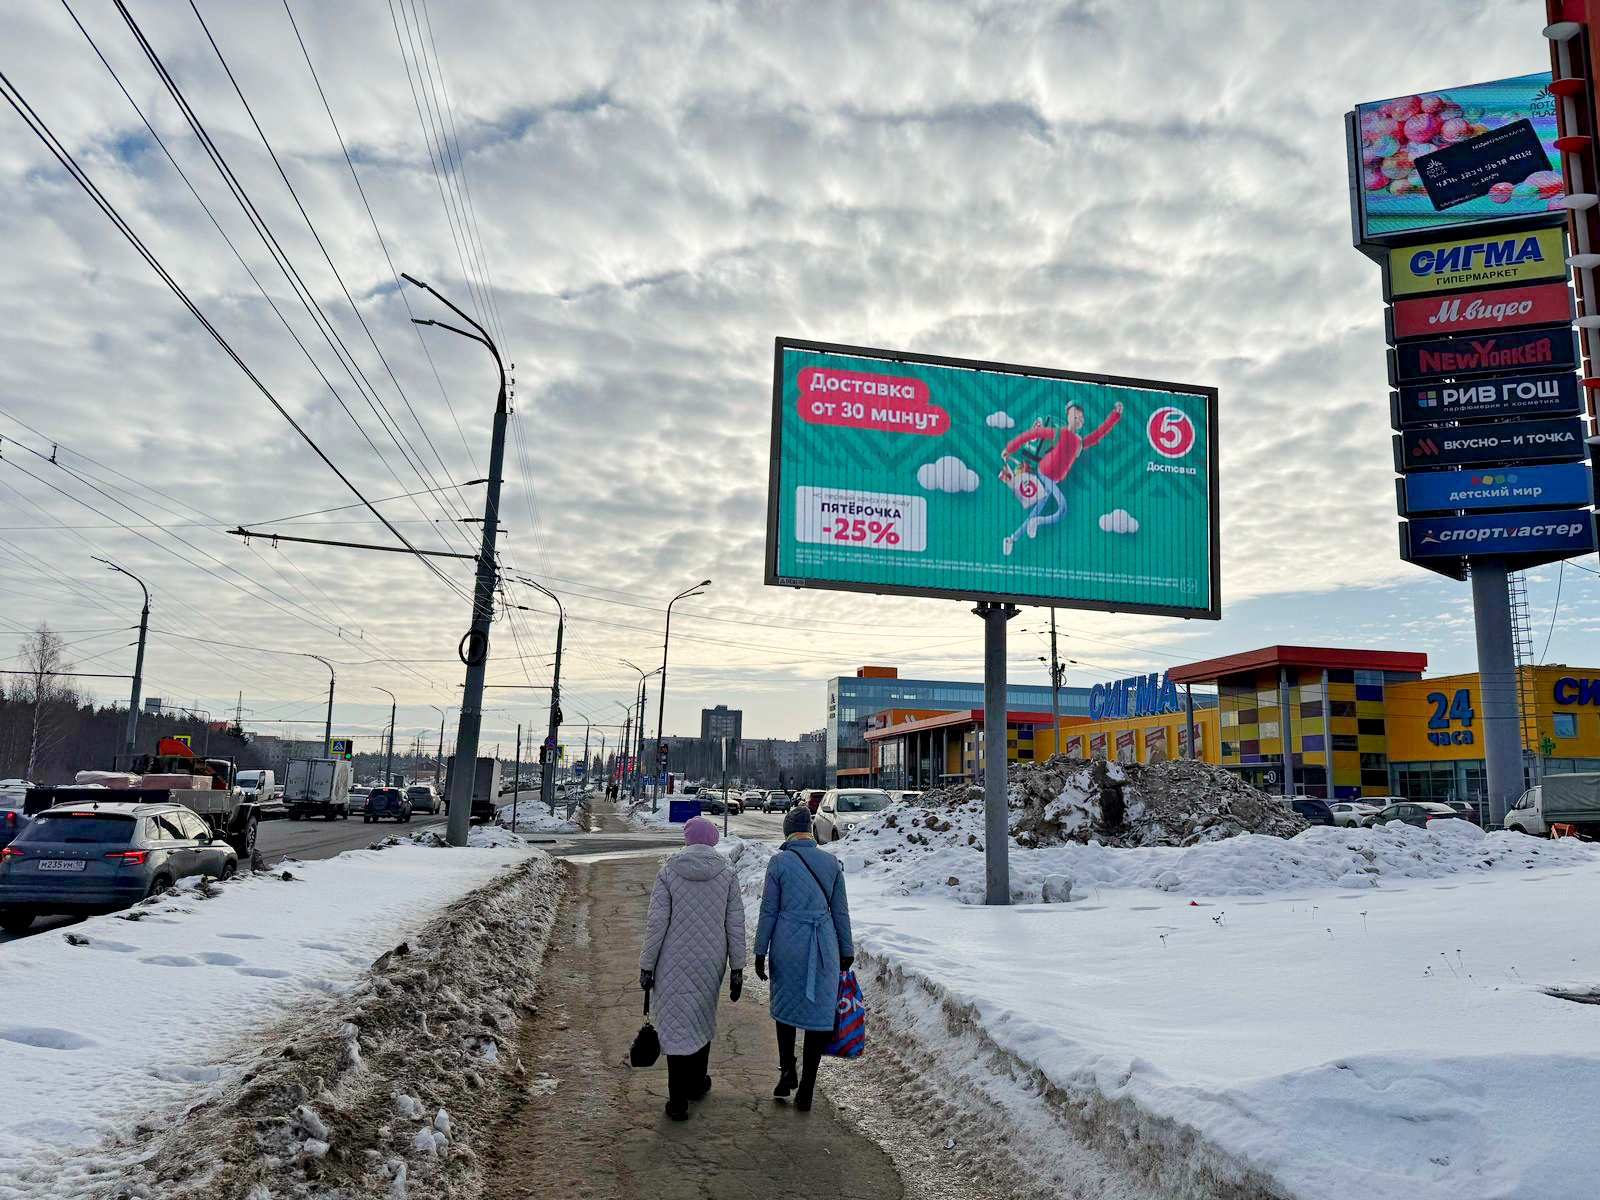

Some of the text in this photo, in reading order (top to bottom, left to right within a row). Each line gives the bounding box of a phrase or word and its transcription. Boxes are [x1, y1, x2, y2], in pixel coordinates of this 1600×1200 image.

[1409, 236, 1544, 277] СИГМА
[1436, 268, 1519, 285] ГИПЕРМАРКЕТ
[1428, 299, 1533, 325] М.видео
[810, 373, 915, 399] Доставка
[1442, 380, 1560, 405] РИВ ГОШ
[811, 402, 940, 430] от 30 минут
[1443, 438, 1499, 450] ВКУСНО
[1513, 436, 1524, 445] И
[1526, 432, 1575, 444] ТОЧКА
[1147, 461, 1197, 475] Доставка
[1449, 486, 1543, 501] детский мир
[821, 501, 902, 519] ПЯТЁРОЧКА
[822, 517, 900, 545] -25%
[1439, 523, 1584, 542] спортмастер
[1089, 670, 1181, 721] СИГМА
[1427, 688, 1474, 729] 24
[1427, 729, 1473, 746] часа
